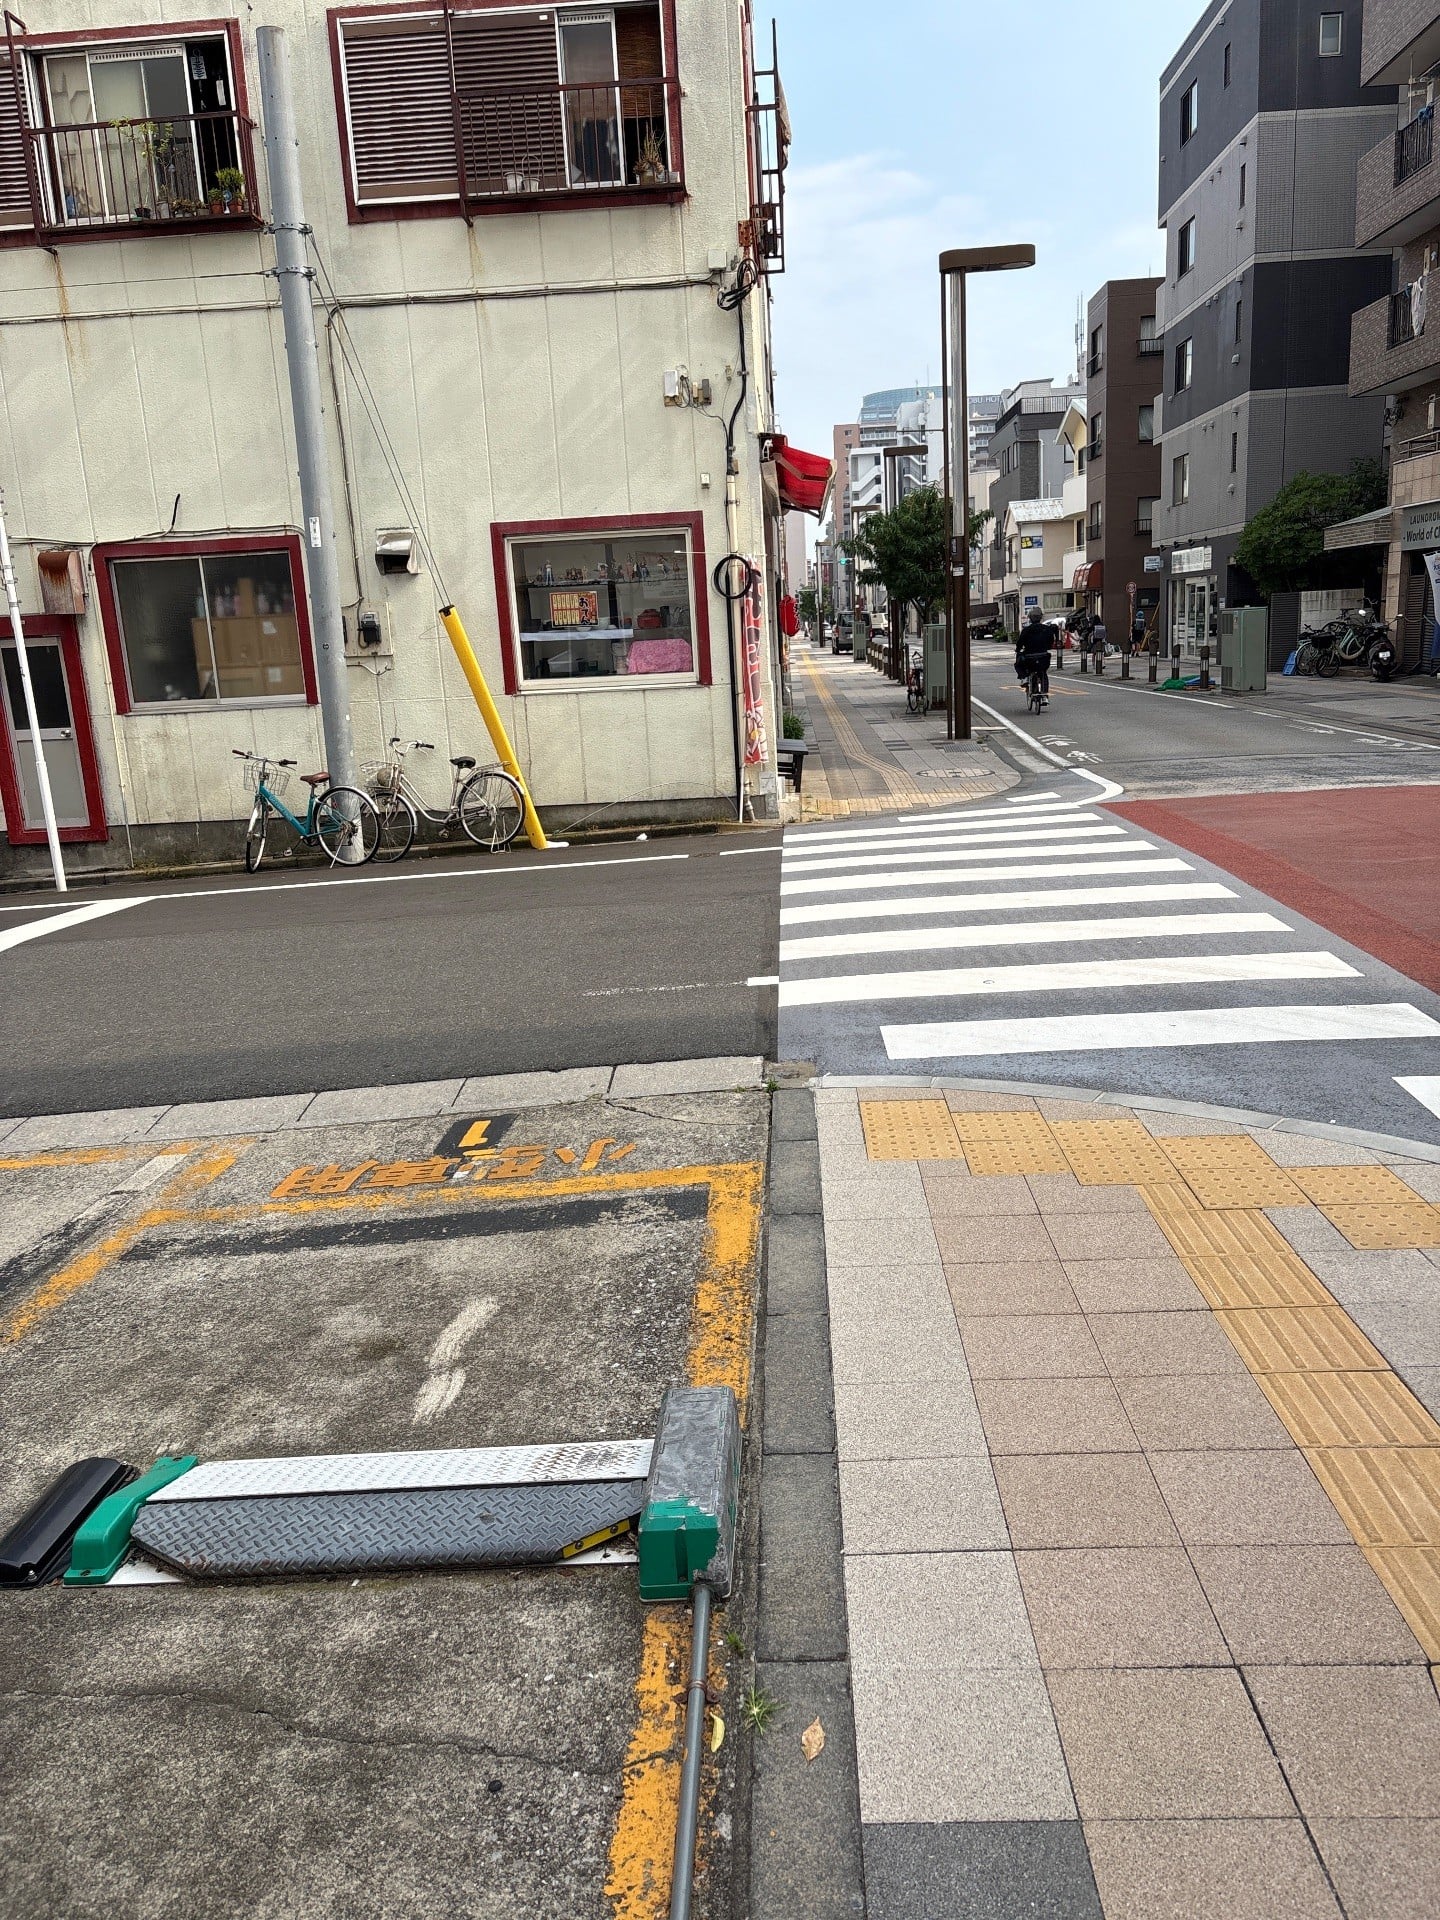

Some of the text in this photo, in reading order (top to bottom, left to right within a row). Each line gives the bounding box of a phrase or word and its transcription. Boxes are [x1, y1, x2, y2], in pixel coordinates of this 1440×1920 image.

[1406, 528, 1425, 542] World
[1426, 527, 1434, 540] of
[458, 1119, 493, 1148] 1
